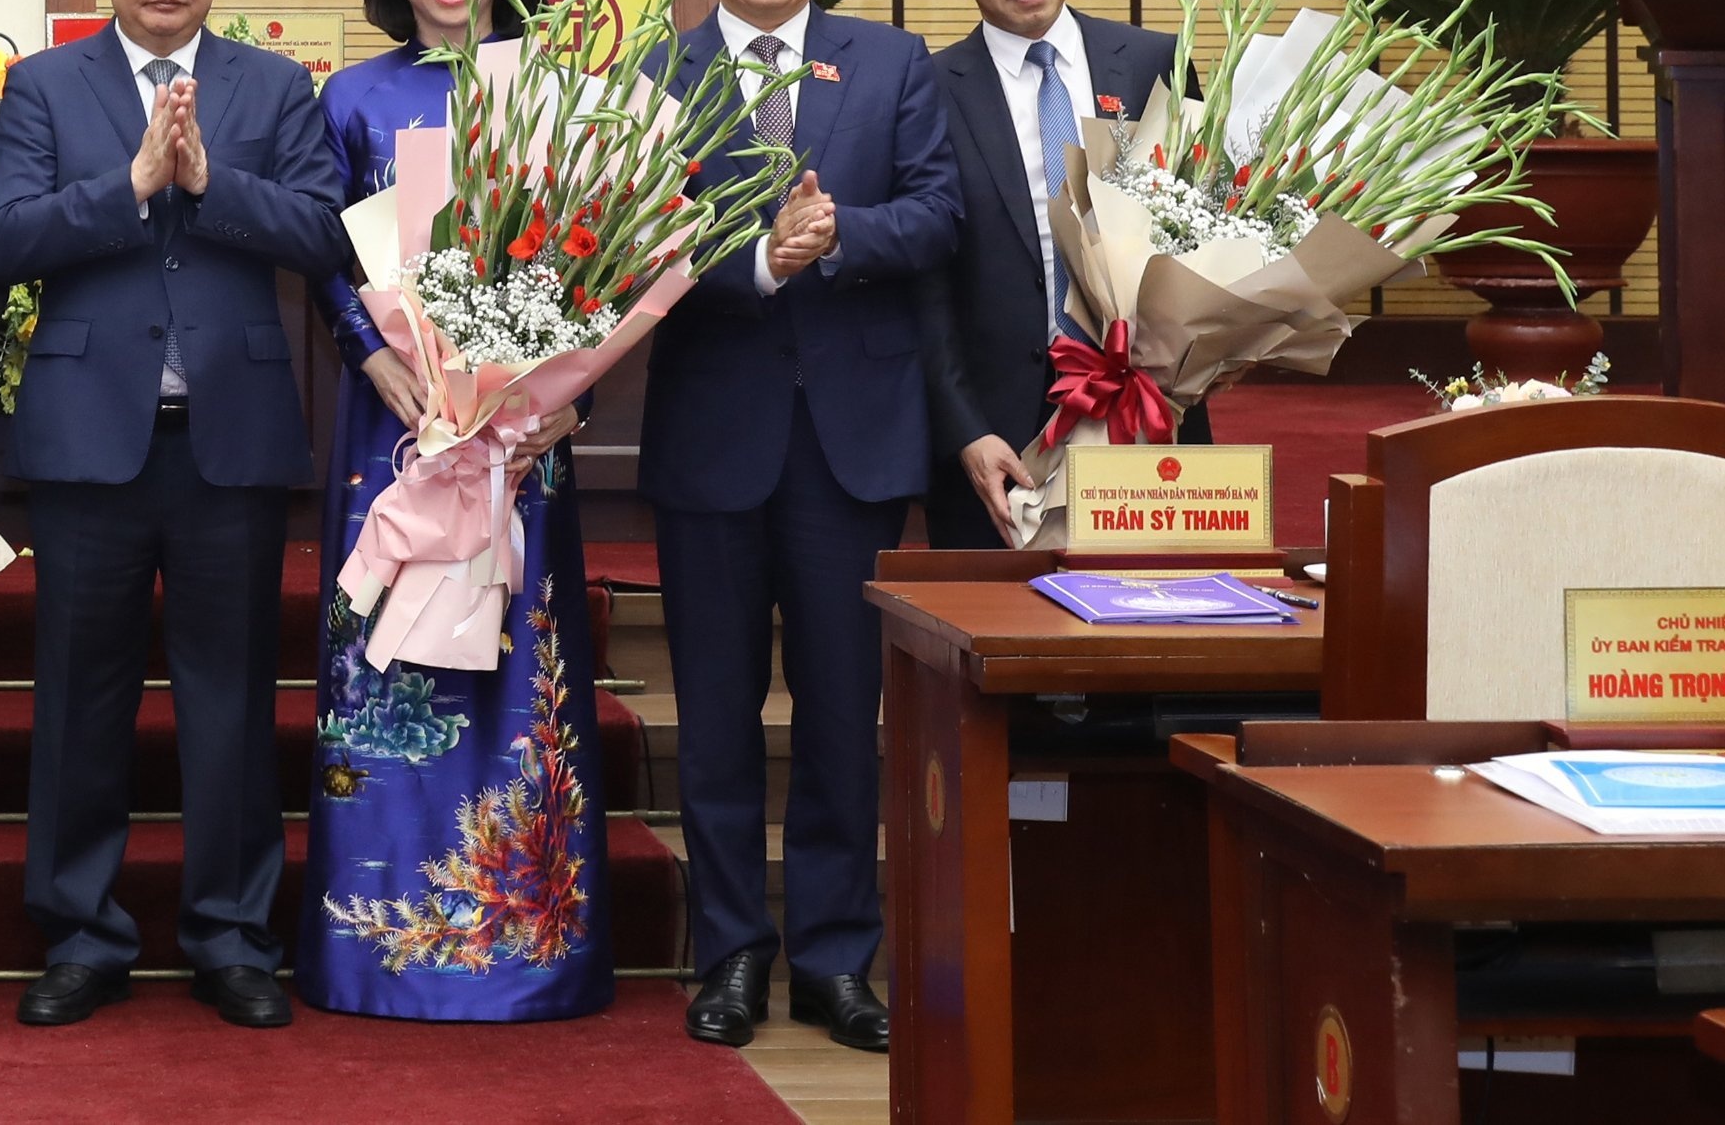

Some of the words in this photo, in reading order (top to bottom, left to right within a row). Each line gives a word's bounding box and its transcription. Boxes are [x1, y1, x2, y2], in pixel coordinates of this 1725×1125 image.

[1080, 485, 1097, 500] CHỦ
[1098, 488, 1117, 502] TỊCH
[1118, 485, 1130, 500] ỦY
[1130, 488, 1146, 500] BAN
[1146, 486, 1169, 500] NHÂN
[1170, 486, 1186, 500] DÂN
[1186, 485, 1213, 500] THÀNH
[1214, 484, 1231, 500] PHỐ
[1231, 486, 1243, 500] HÀ
[1244, 487, 1259, 502] NỘI
[1090, 502, 1144, 531] TRẦN
[1150, 506, 1177, 531] SỸ
[1182, 509, 1250, 531] THANH
[1657, 613, 1691, 630] CHỦ
[1591, 636, 1613, 653] ỦY
[1617, 640, 1650, 653] BAN
[1654, 634, 1693, 653] KIỂM
[1588, 668, 1664, 699] HOÀNG
